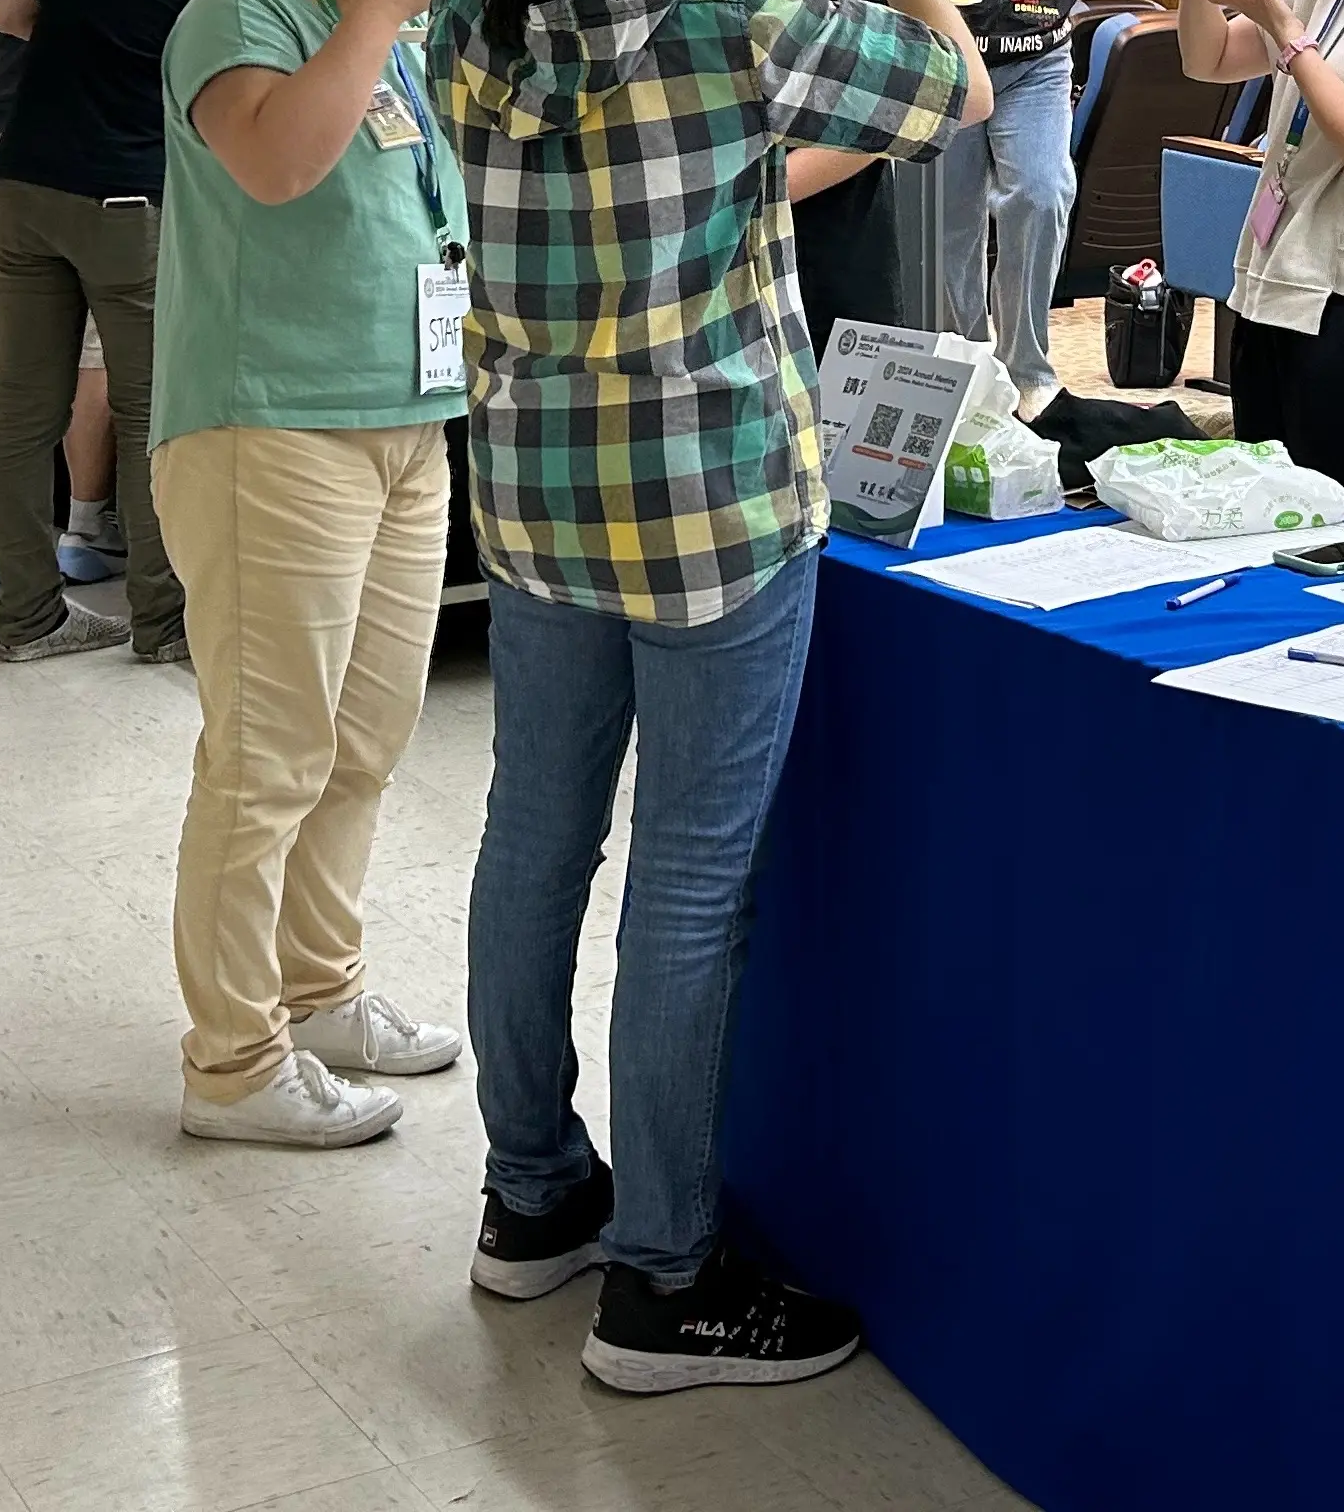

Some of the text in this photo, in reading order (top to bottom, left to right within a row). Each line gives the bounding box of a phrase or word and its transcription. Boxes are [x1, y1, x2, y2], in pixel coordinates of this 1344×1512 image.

[1000, 34, 1044, 53] INARIS
[429, 316, 462, 352] STAF
[679, 1320, 726, 1338] FILA
